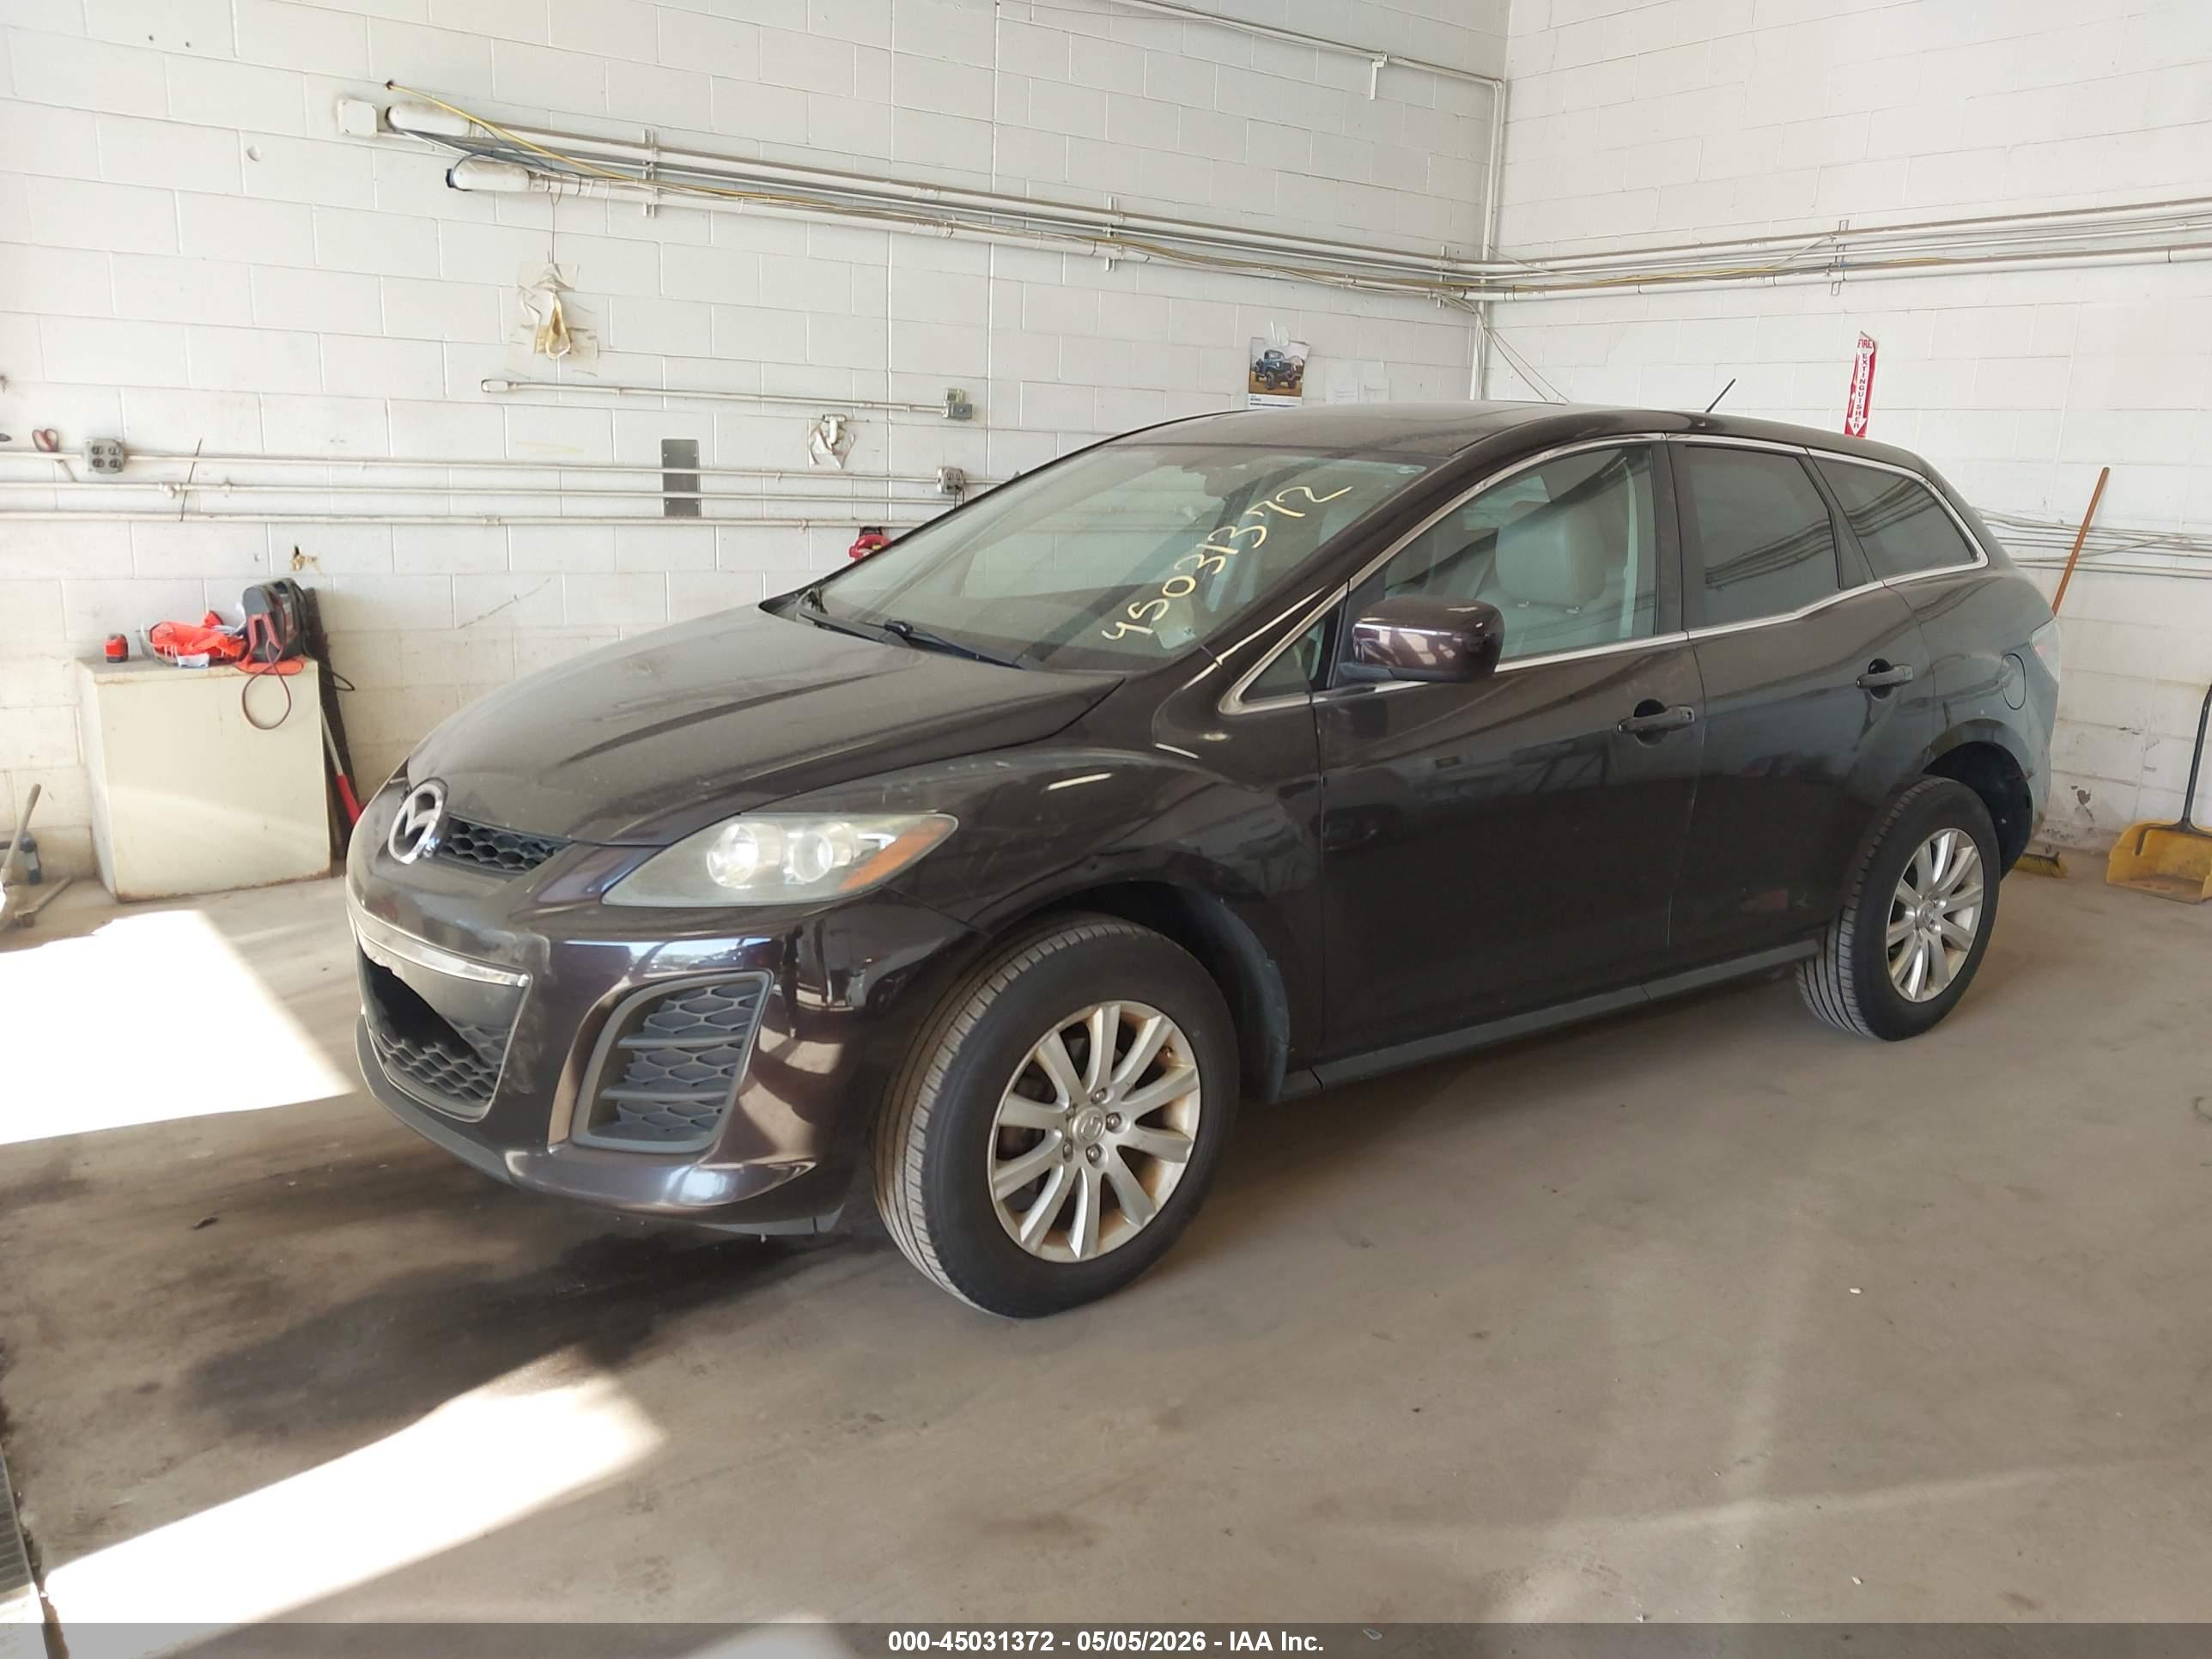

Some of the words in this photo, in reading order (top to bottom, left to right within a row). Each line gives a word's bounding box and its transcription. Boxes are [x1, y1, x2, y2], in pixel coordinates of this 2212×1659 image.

[1857, 339, 1873, 349] FIRE
[1854, 353, 1869, 428] EXTINGUISHER
[1101, 486, 1353, 640] 45031372
